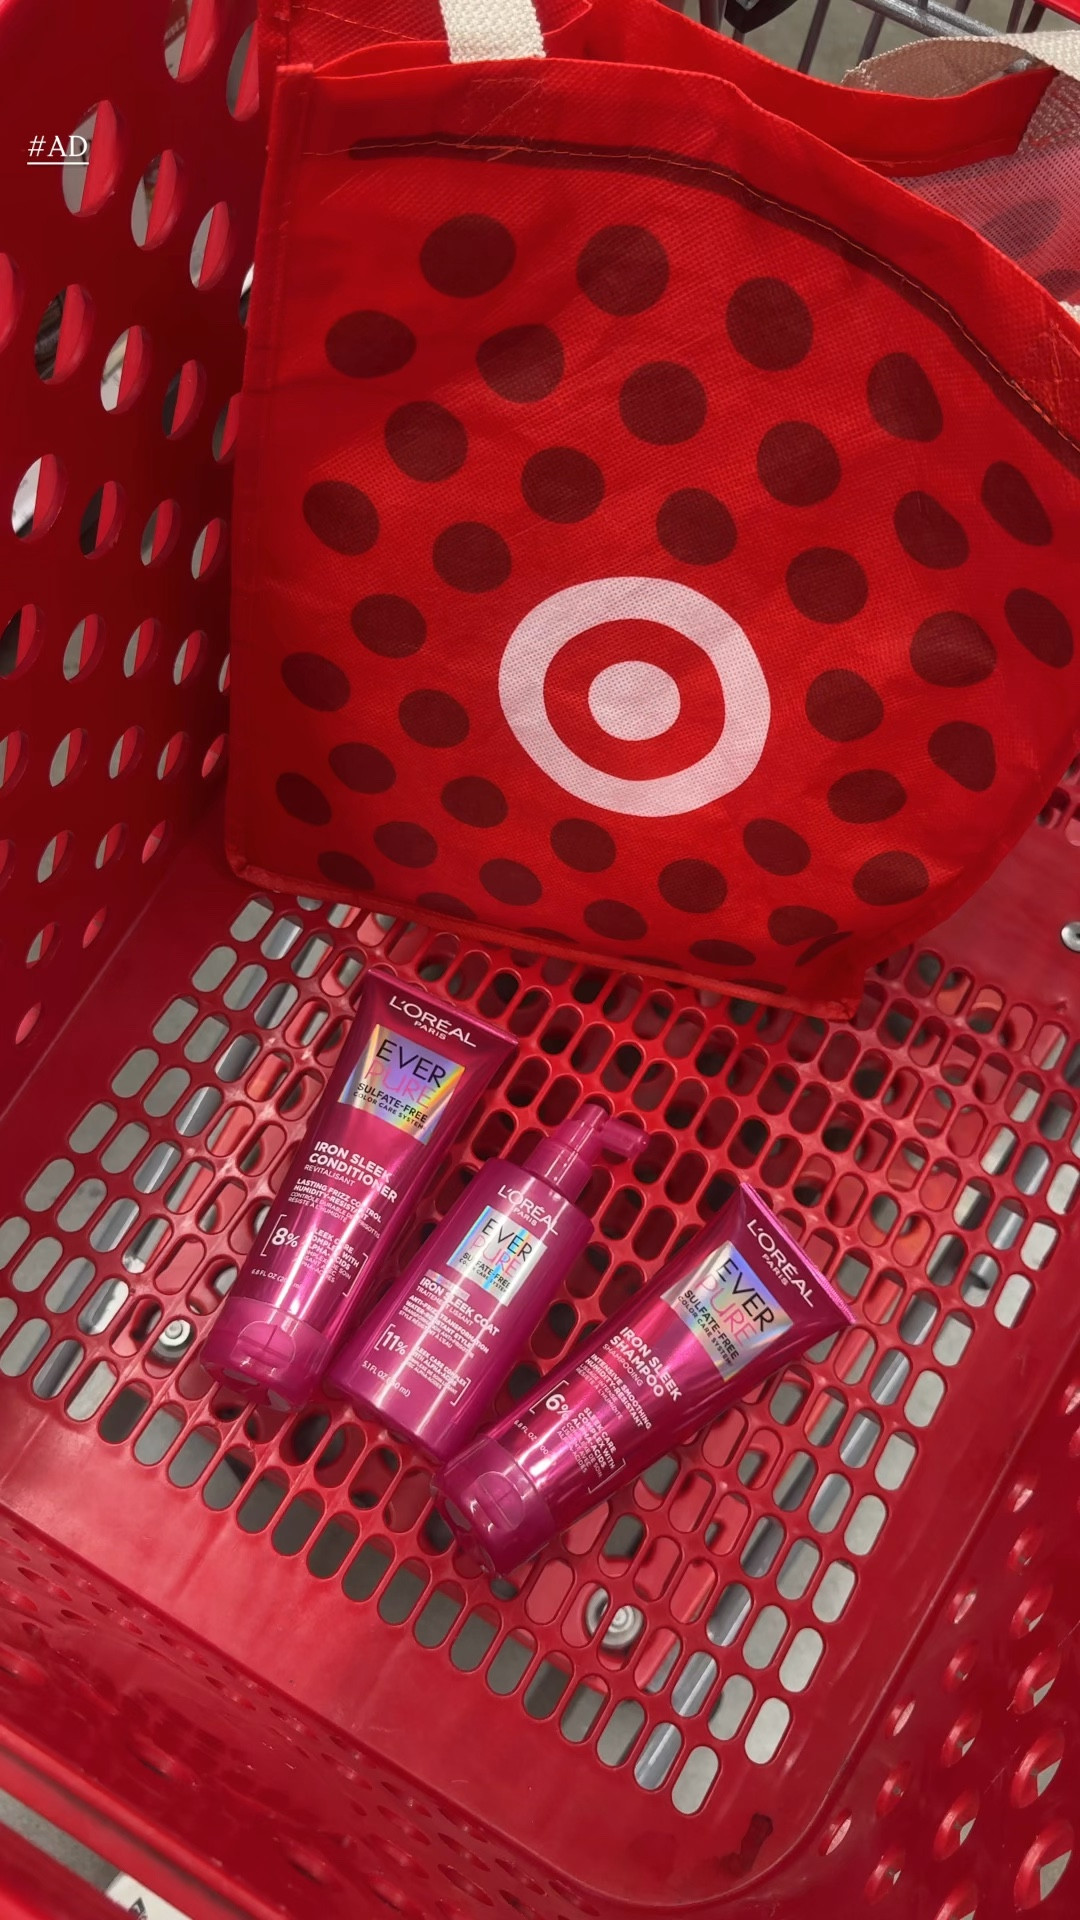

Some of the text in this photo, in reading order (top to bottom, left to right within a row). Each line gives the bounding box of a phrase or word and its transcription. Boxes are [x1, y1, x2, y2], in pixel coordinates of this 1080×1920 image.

[414, 1020, 446, 1040] PARIS
[364, 1058, 436, 1109] PURE
[376, 1039, 446, 1088] EVER
[353, 1091, 377, 1104] COLOR
[378, 1102, 396, 1114] CARE
[356, 1082, 428, 1122] SULFATE-FREE
[304, 1163, 355, 1186] REVITALISANT
[309, 1151, 398, 1203] CONDITIONER
[314, 1141, 392, 1183] IRON SLEEK
[288, 1197, 309, 1206] RÉSISTE
[297, 1179, 381, 1223] LASTING FRIZZ COTROL
[319, 1199, 346, 1215] DURABLE
[513, 1207, 537, 1226] PARIS
[271, 1226, 299, 1248] 8%
[312, 1226, 354, 1254] LEEK CRE
[469, 1234, 521, 1277] PURE
[482, 1218, 532, 1261] EVER
[342, 1251, 359, 1267] WITH
[476, 1269, 489, 1280] CARE
[761, 1253, 788, 1286] PARIS
[419, 1277, 500, 1336] IRON SLEEK COAT
[694, 1274, 757, 1346] PURE
[715, 1258, 774, 1332] EVER
[449, 1307, 473, 1326] LISSANT
[677, 1296, 697, 1318] COLOR
[696, 1317, 712, 1337] CARE
[683, 1289, 739, 1360] SULFATE-FREE
[381, 1331, 408, 1355] 11%
[361, 1359, 371, 1369] 5.1
[369, 1364, 378, 1374] FL
[376, 1370, 387, 1380] OZ
[398, 1386, 410, 1397] ml)
[429, 1355, 445, 1368] CARE
[443, 1365, 467, 1386] COMPLEX
[579, 1363, 618, 1402] LISSAGE INTENSE
[602, 1343, 643, 1386] SHAMPOOING
[609, 1334, 665, 1396] SHAMPOO
[619, 1326, 682, 1401] IRON SLEEK
[545, 1394, 573, 1420] 6%
[584, 1358, 643, 1427] HUMIDITY-RESISTANT
[590, 1353, 651, 1429] INTENSIVE SMOOTHING
[520, 1425, 528, 1433] FL
[527, 1431, 536, 1441] OZ
[571, 1417, 606, 1468] ALPHA-ACIDS
[577, 1412, 615, 1469] COMPLEX WITH
[583, 1407, 617, 1452] SLEEK CARE
[578, 1450, 592, 1468] AVEC
[588, 1452, 596, 1462] DE
